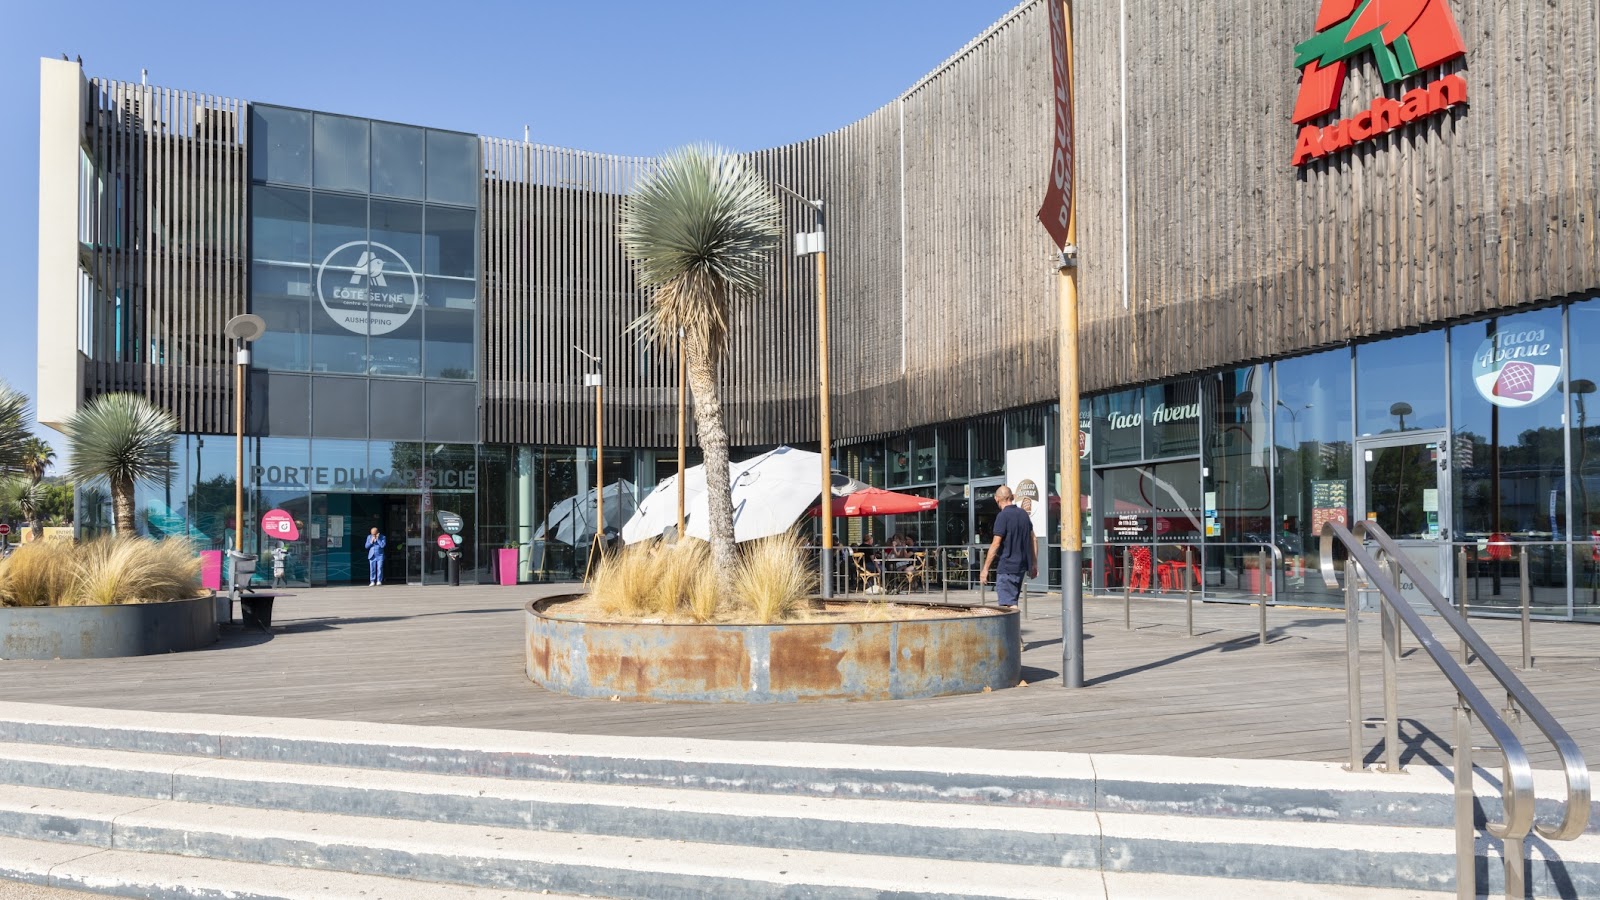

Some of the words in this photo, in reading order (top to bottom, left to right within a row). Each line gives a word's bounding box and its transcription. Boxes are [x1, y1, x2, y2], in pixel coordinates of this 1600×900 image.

[1291, 74, 1467, 167] Auchan
[370, 292, 403, 303] SEYNE
[1491, 328, 1545, 349] Tacos
[1479, 343, 1551, 368] Avenue
[1108, 410, 1141, 430] Taco
[1152, 402, 1200, 426] Avenu
[251, 465, 329, 485] PORTE
[335, 466, 364, 486] DU
[371, 468, 416, 487] CAP
[425, 465, 476, 487] SICIÉ
[1019, 482, 1036, 490] Tacos
